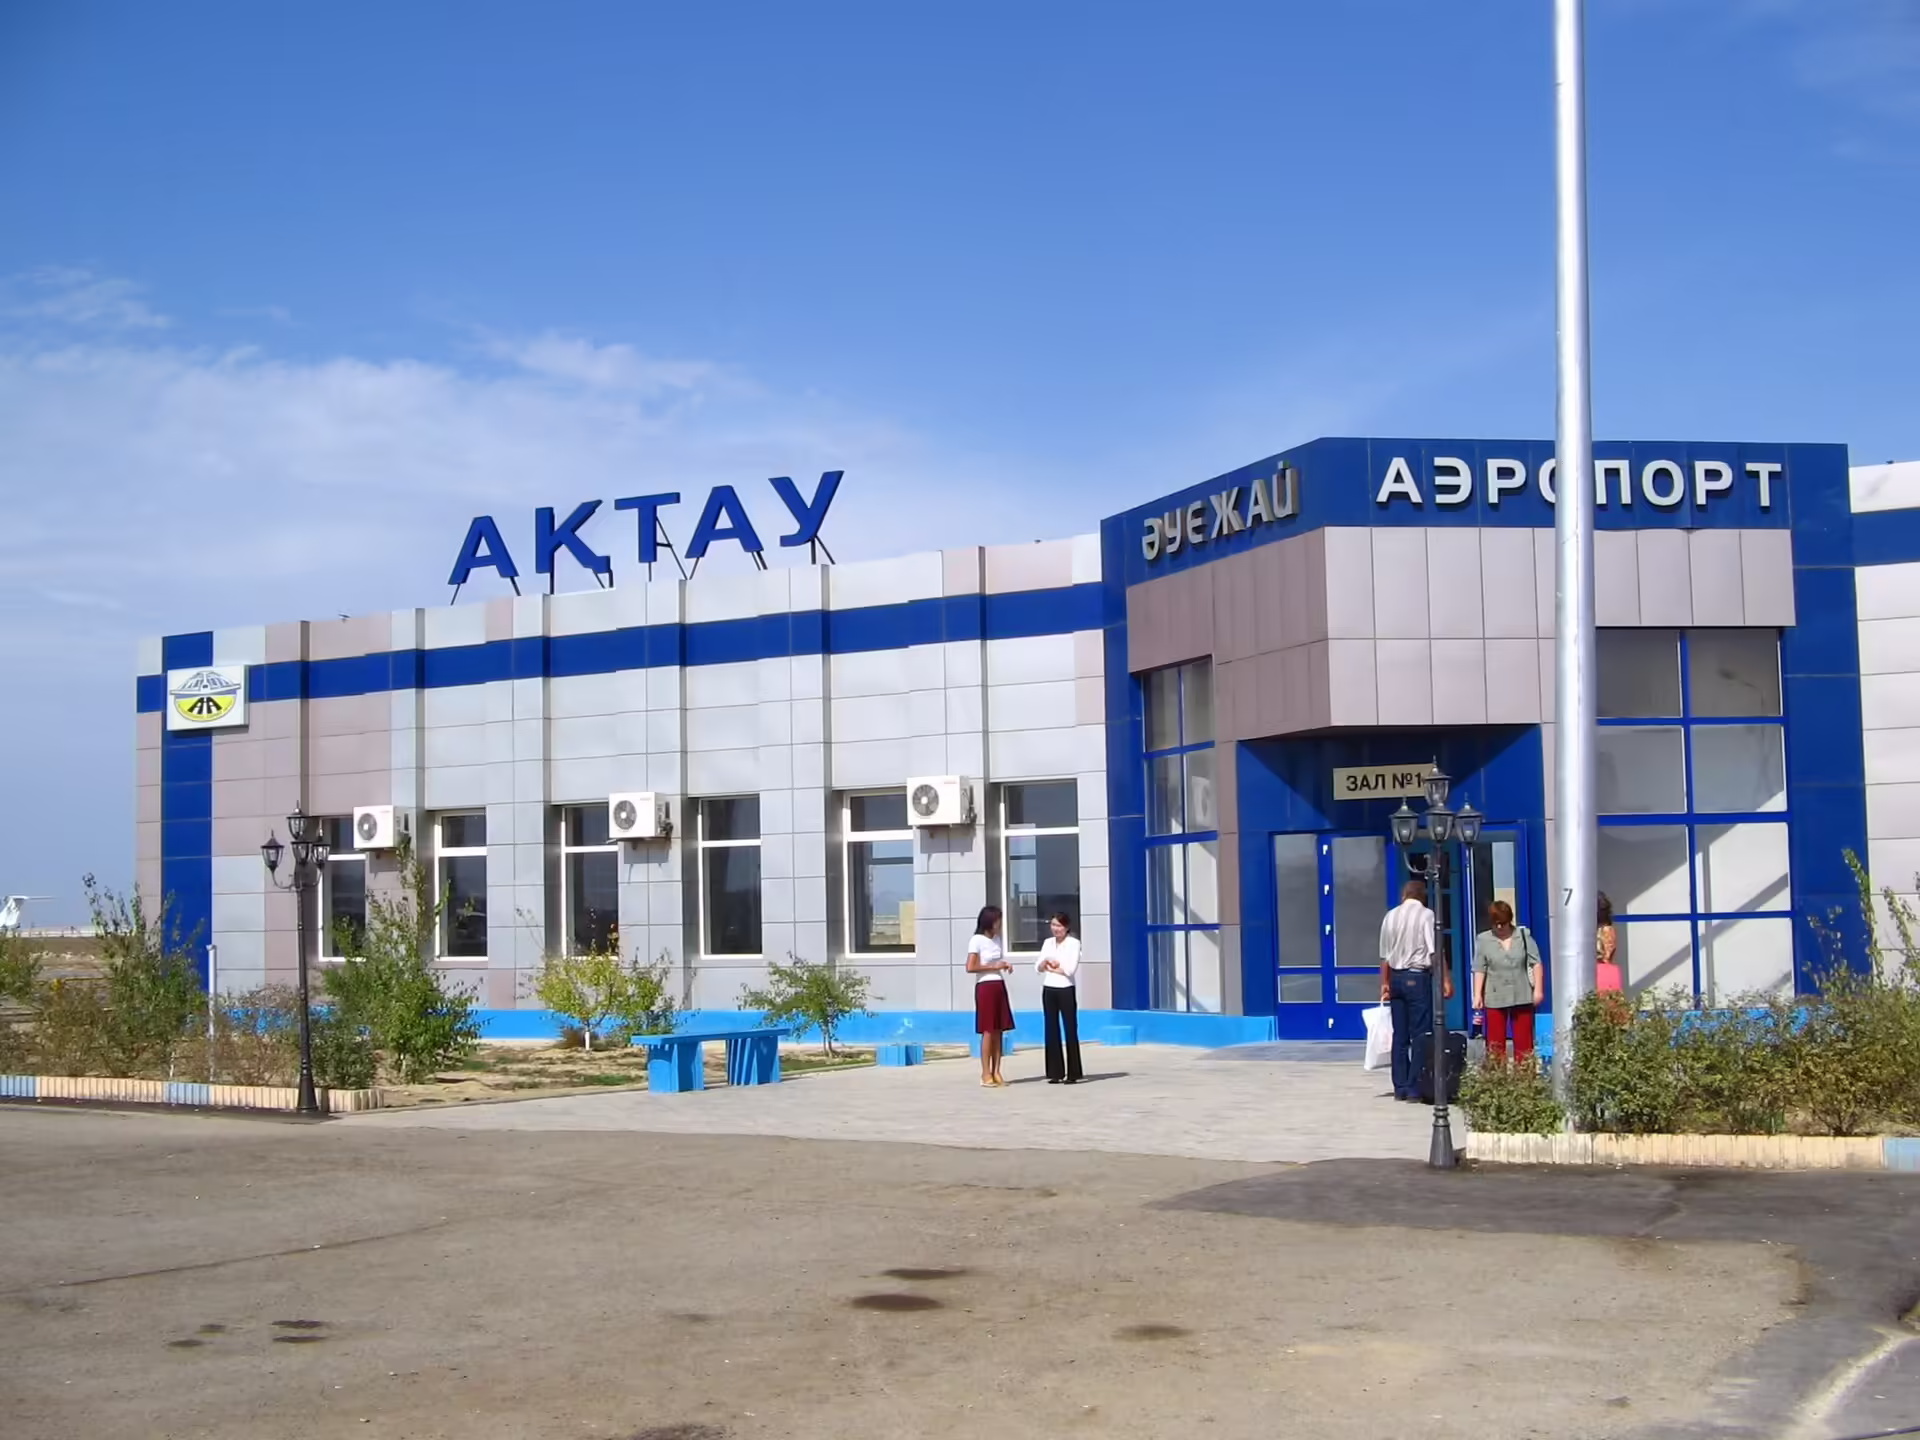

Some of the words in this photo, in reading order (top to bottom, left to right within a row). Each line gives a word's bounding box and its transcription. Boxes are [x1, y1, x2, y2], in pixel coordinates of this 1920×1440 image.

[1142, 461, 1298, 560] ӘУЕЖАЙ
[1346, 774, 1385, 791] ЗАЛ
[1392, 772, 1422, 789] №1
[1563, 888, 1573, 906] 7
